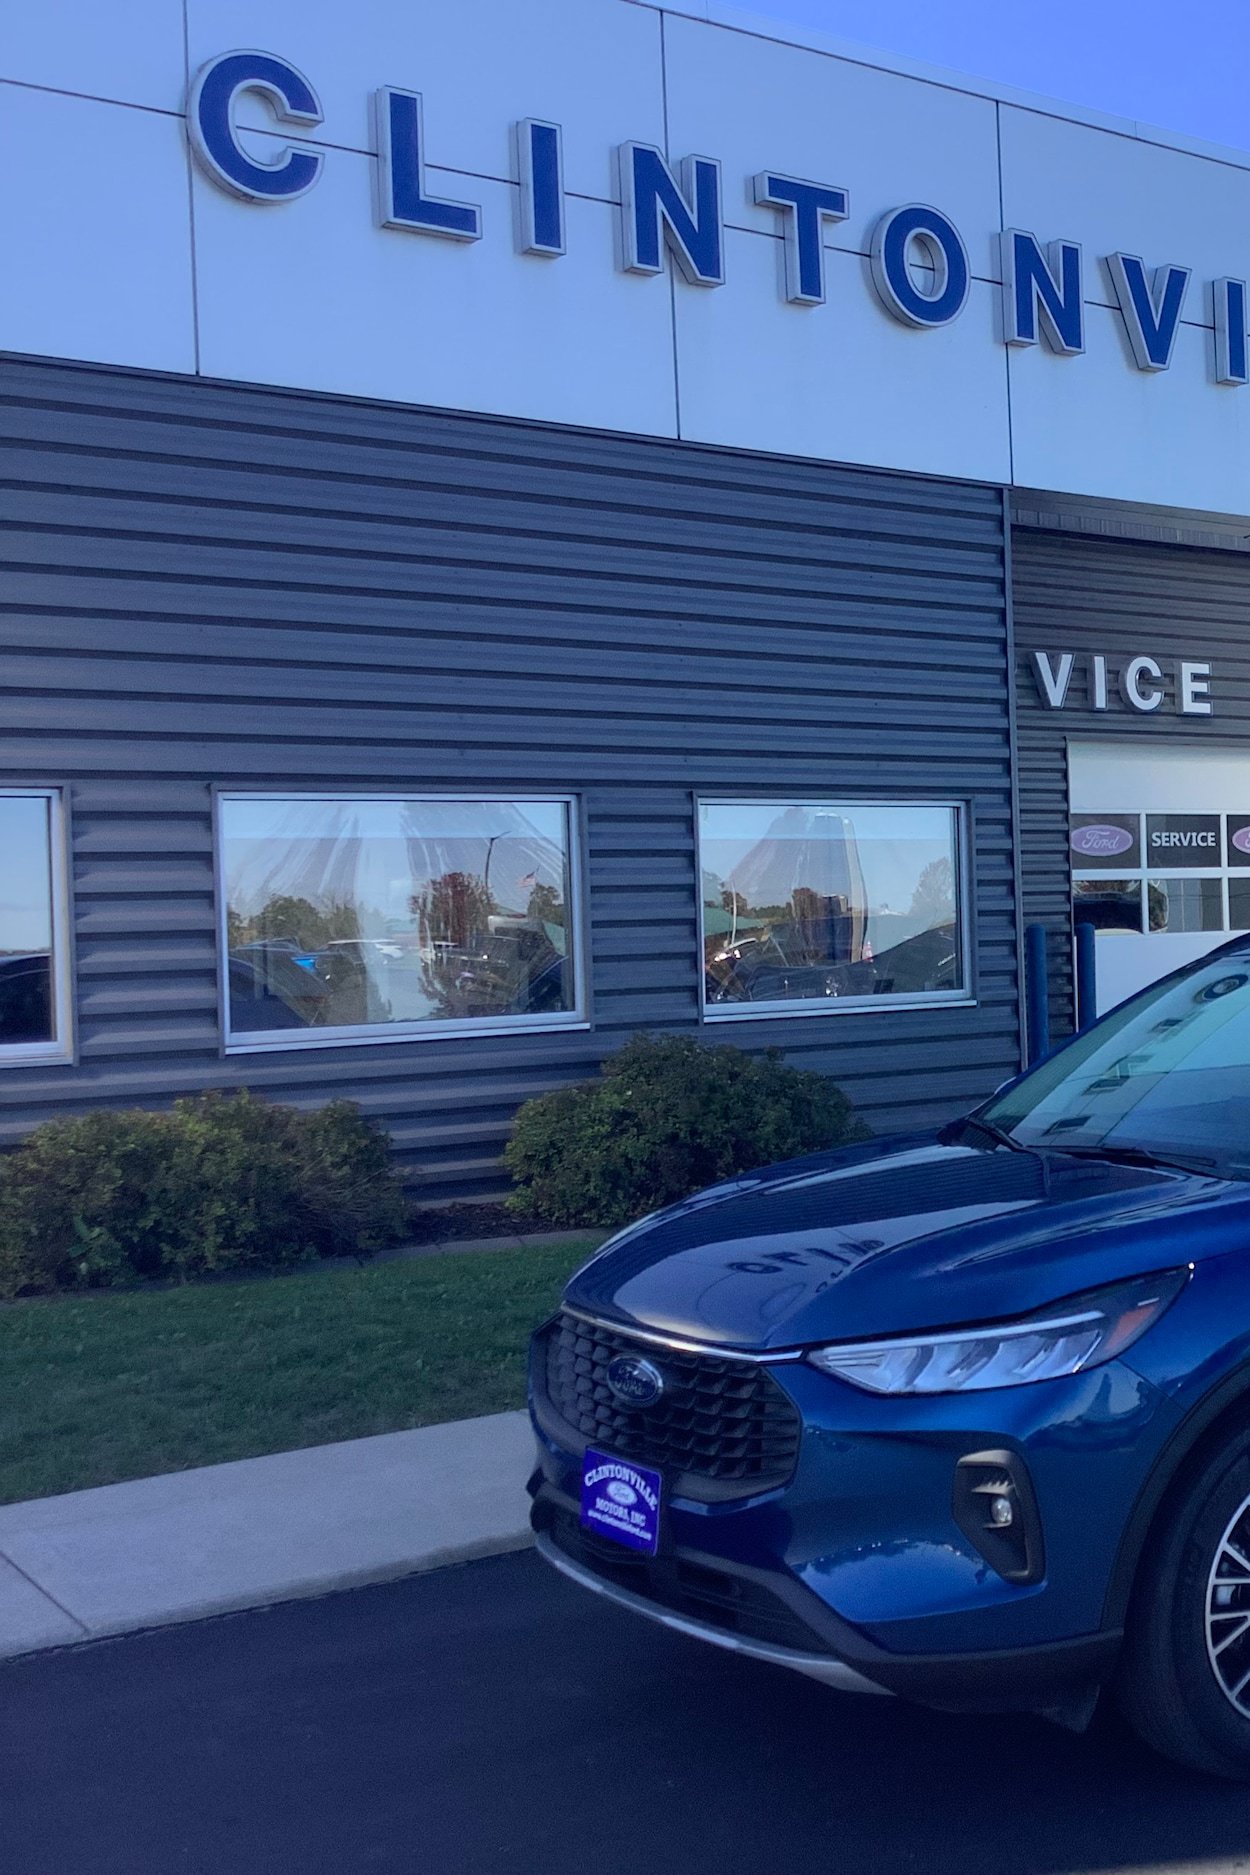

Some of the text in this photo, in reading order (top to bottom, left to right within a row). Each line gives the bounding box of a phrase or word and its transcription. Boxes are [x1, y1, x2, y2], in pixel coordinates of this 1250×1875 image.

[1033, 650, 1214, 716] VICE
[1081, 830, 1120, 849] Ford
[1150, 830, 1217, 848] SERVICE
[584, 1464, 658, 1511] CLINTONVILLE
